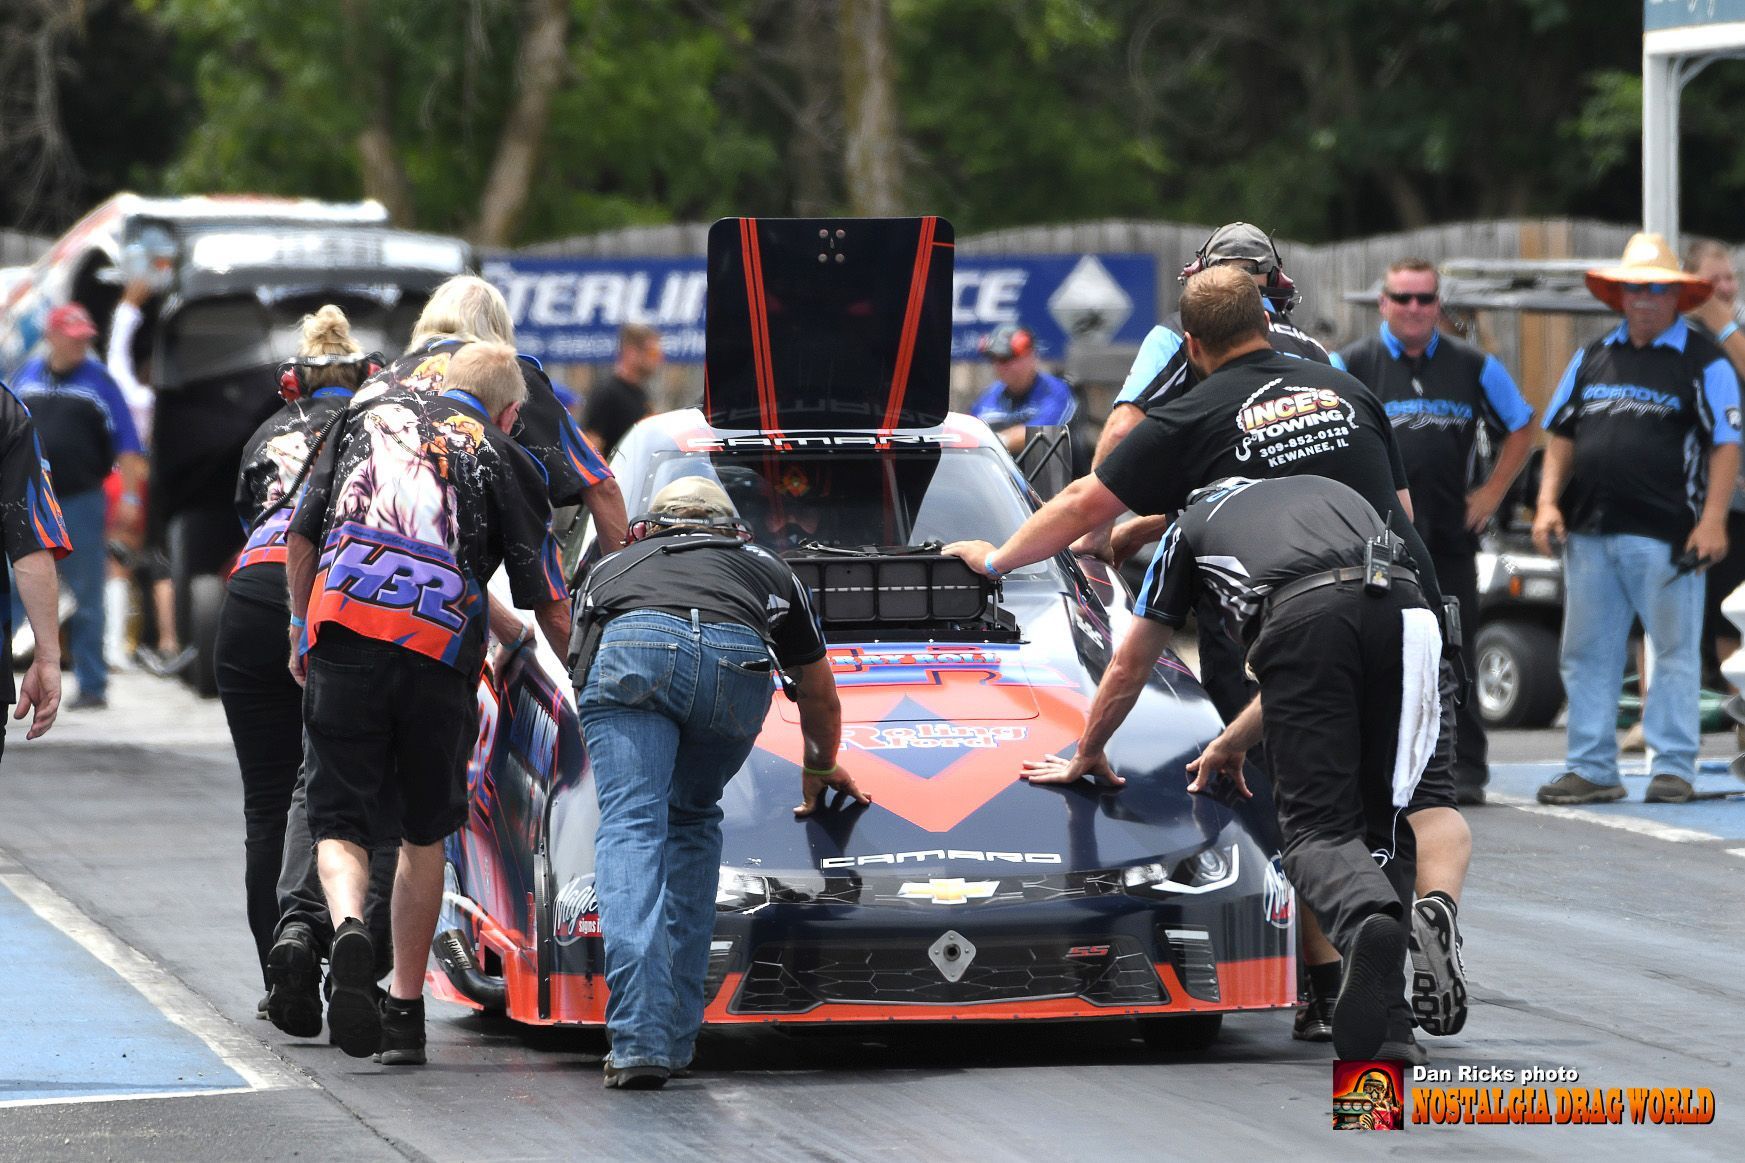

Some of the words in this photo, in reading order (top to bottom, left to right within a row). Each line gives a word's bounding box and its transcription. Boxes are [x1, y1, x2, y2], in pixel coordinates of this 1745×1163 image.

[1242, 388, 1341, 433] INCE'S
[1250, 408, 1345, 442] TOWING
[687, 434, 961, 450] CAMARO
[1259, 426, 1350, 458] 309-852-0128
[1267, 441, 1335, 468] KEWANEE,
[1336, 438, 1350, 450] IL
[821, 849, 1062, 869] CAMARO
